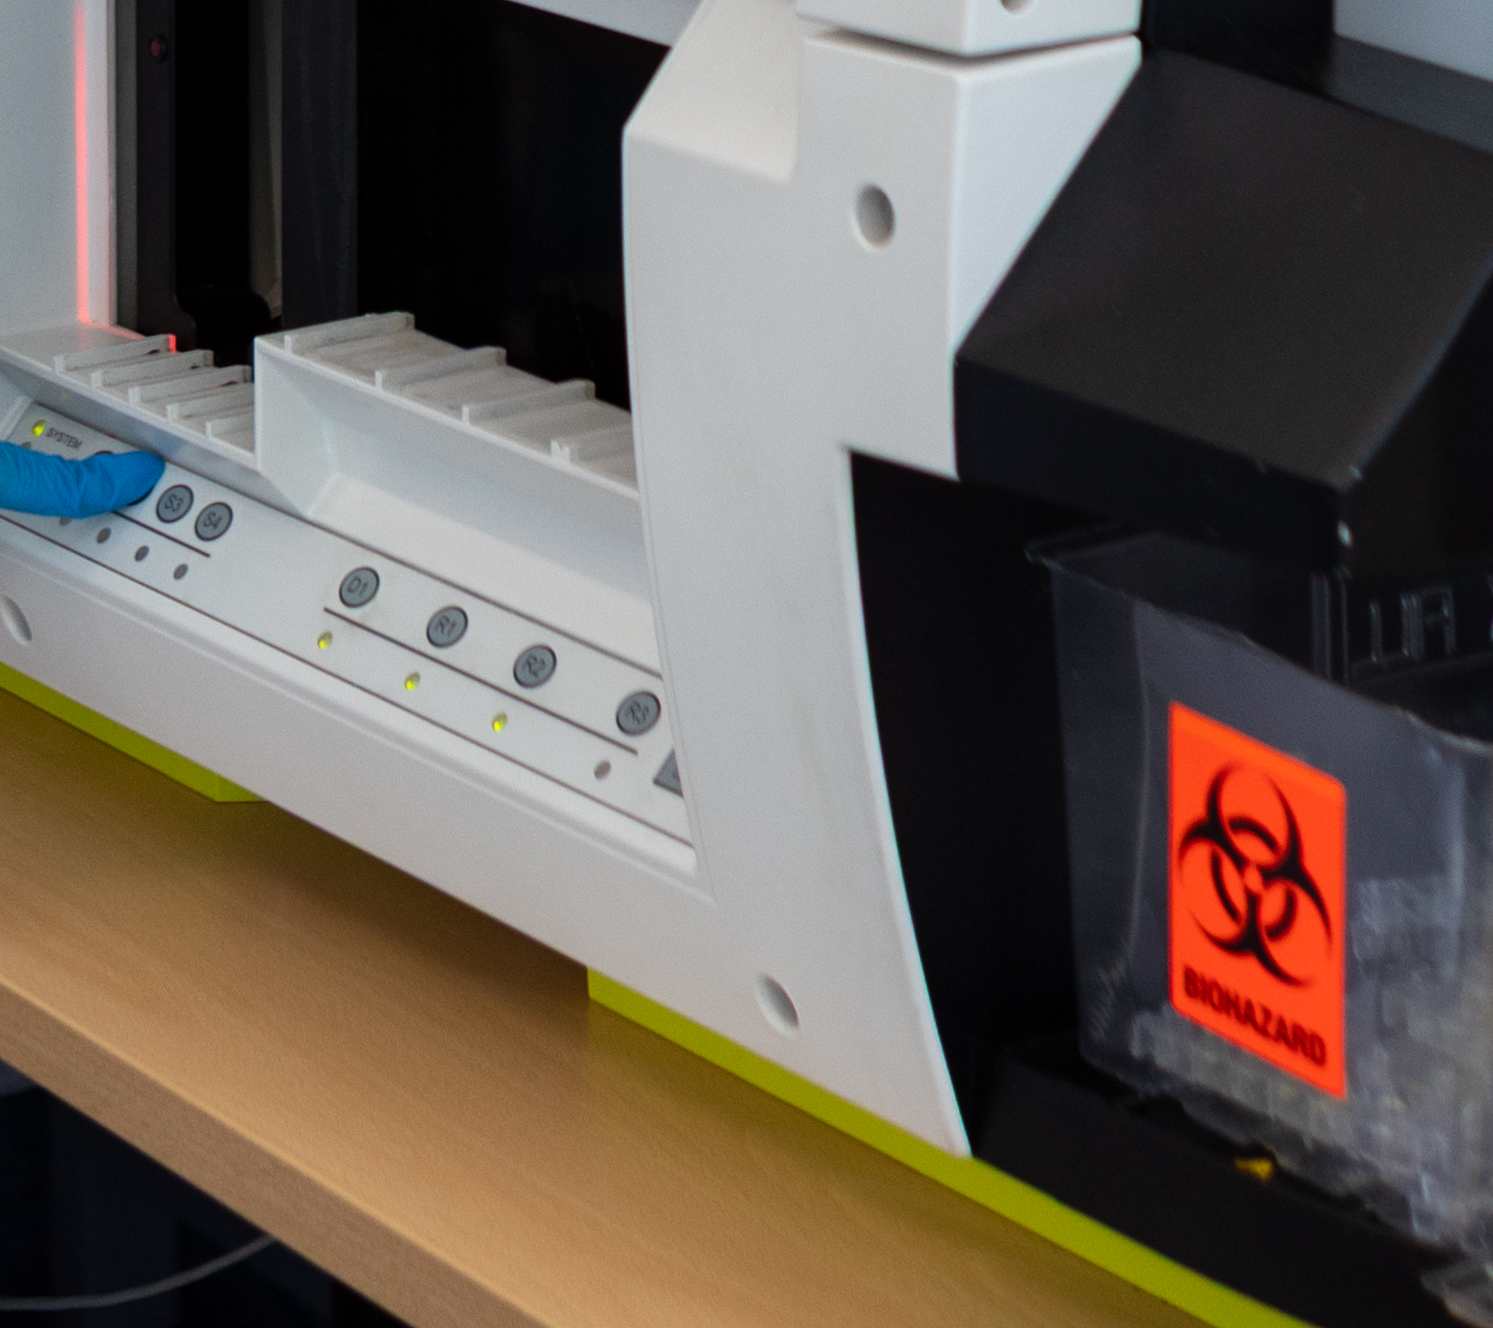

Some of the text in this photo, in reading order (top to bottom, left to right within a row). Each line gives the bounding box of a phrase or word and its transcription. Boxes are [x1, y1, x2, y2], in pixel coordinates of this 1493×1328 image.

[46, 427, 84, 449] SYSTEM
[164, 493, 184, 513] S3
[347, 575, 369, 595] D1
[436, 614, 456, 637] R1
[524, 653, 547, 677] R2
[1182, 963, 1327, 1067] BIOHAZARD
